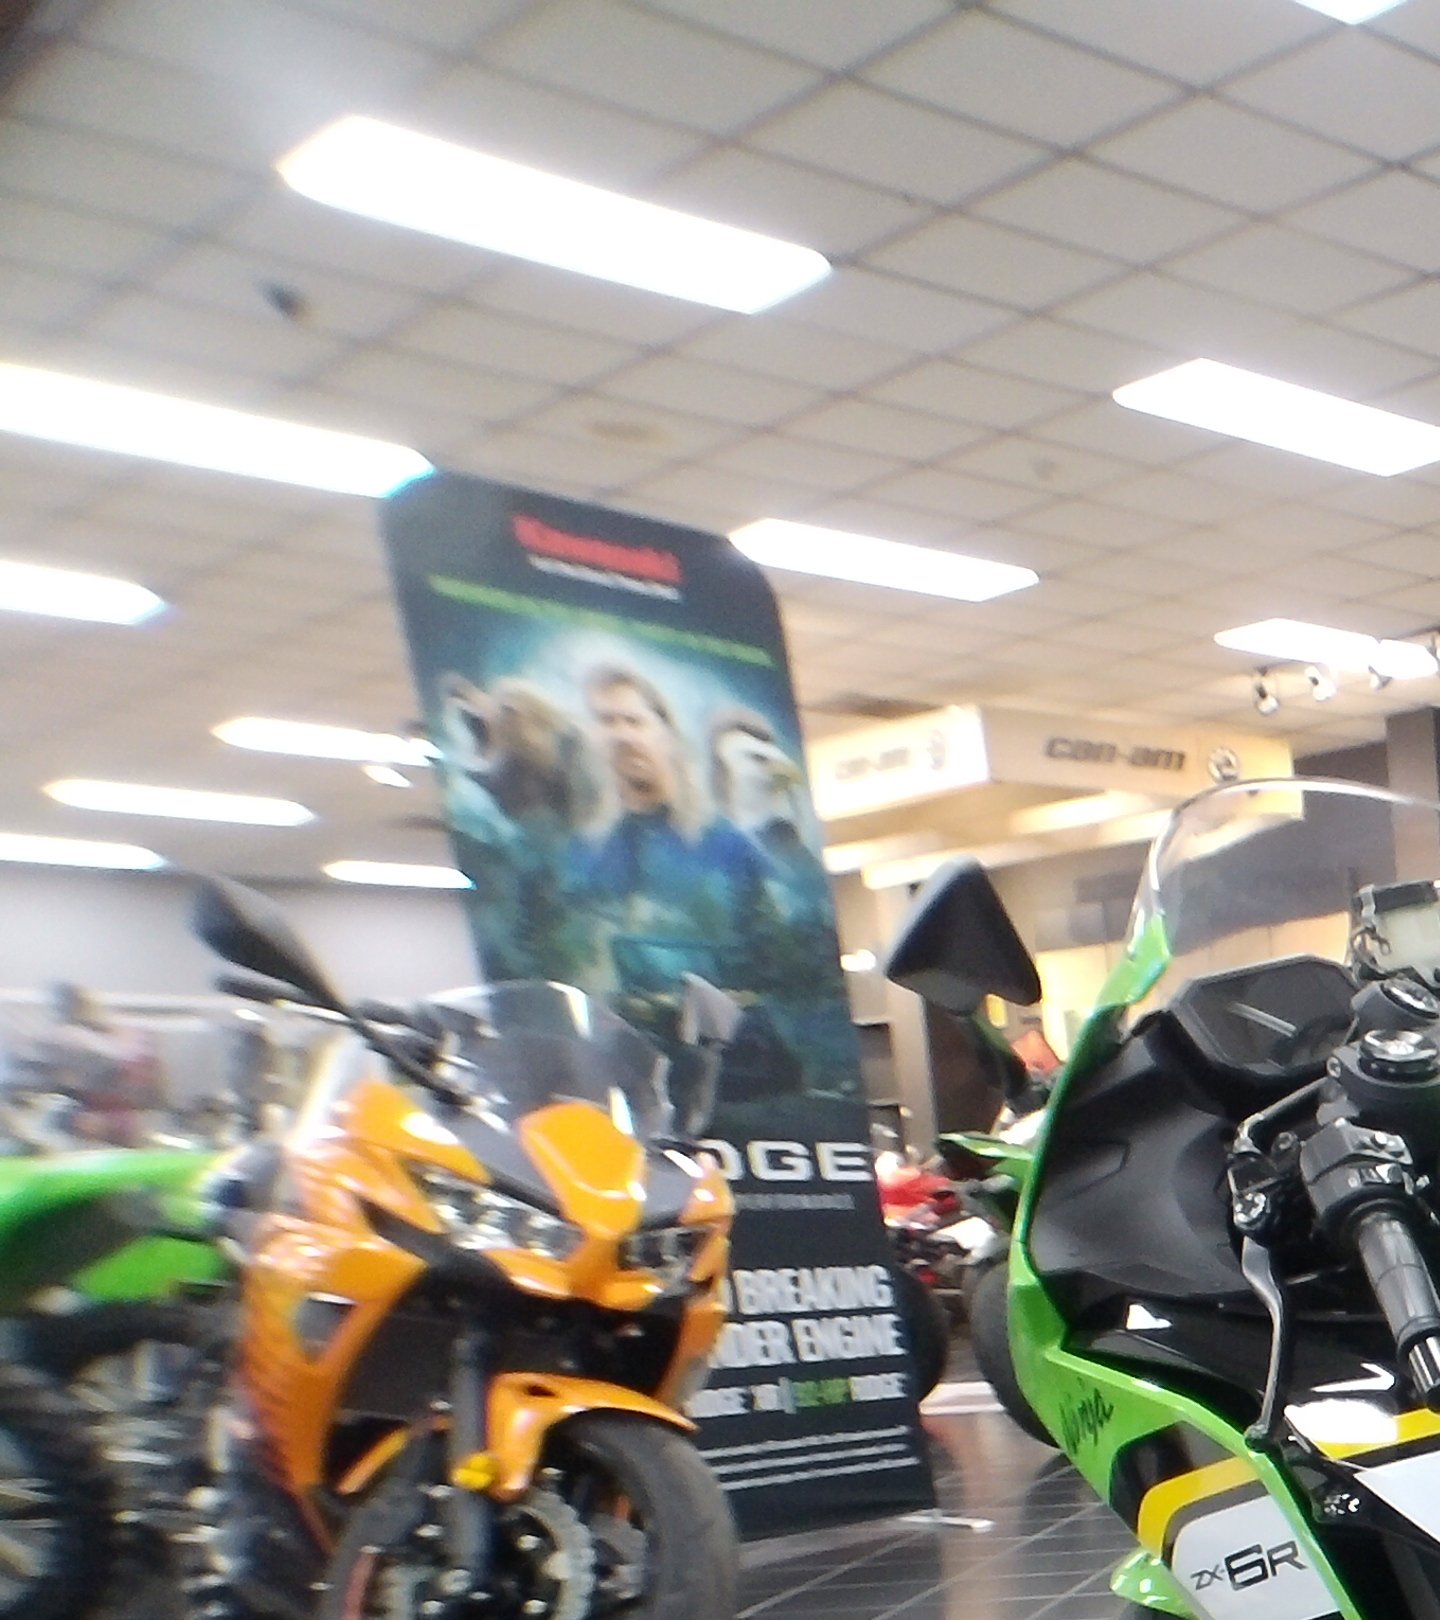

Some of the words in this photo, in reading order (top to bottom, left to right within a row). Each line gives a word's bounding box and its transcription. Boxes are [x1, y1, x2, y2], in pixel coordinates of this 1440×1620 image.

[1045, 736, 1186, 771] can-am
[698, 1138, 875, 1182] DGE
[791, 1313, 909, 1363] ENGINE
[1189, 1541, 1309, 1592] ZX-6R
